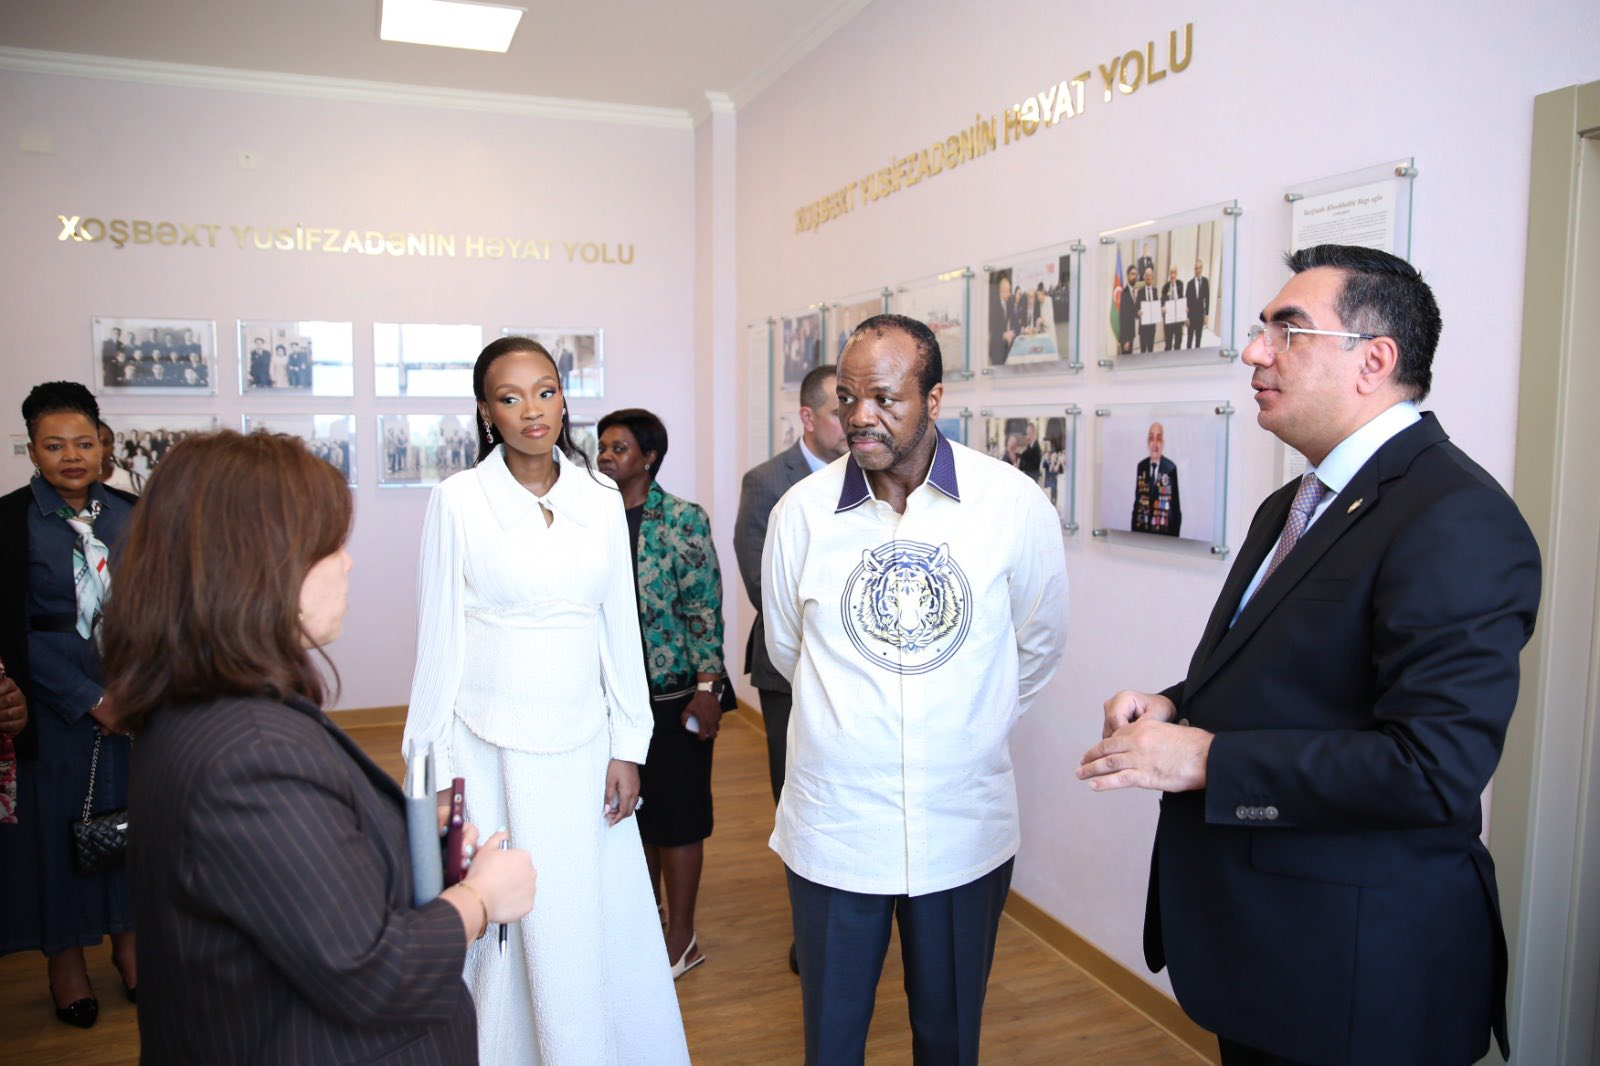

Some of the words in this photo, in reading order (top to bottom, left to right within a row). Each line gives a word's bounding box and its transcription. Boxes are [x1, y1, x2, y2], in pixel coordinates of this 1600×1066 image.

[1003, 70, 1091, 145] HƏYAT
[1098, 22, 1193, 103] YOLU
[57, 214, 221, 249] XOŞBƏXT
[230, 222, 456, 257] YUSİFZADƏNİN
[465, 234, 553, 261] HƏYAT
[562, 241, 635, 265] YOLU
